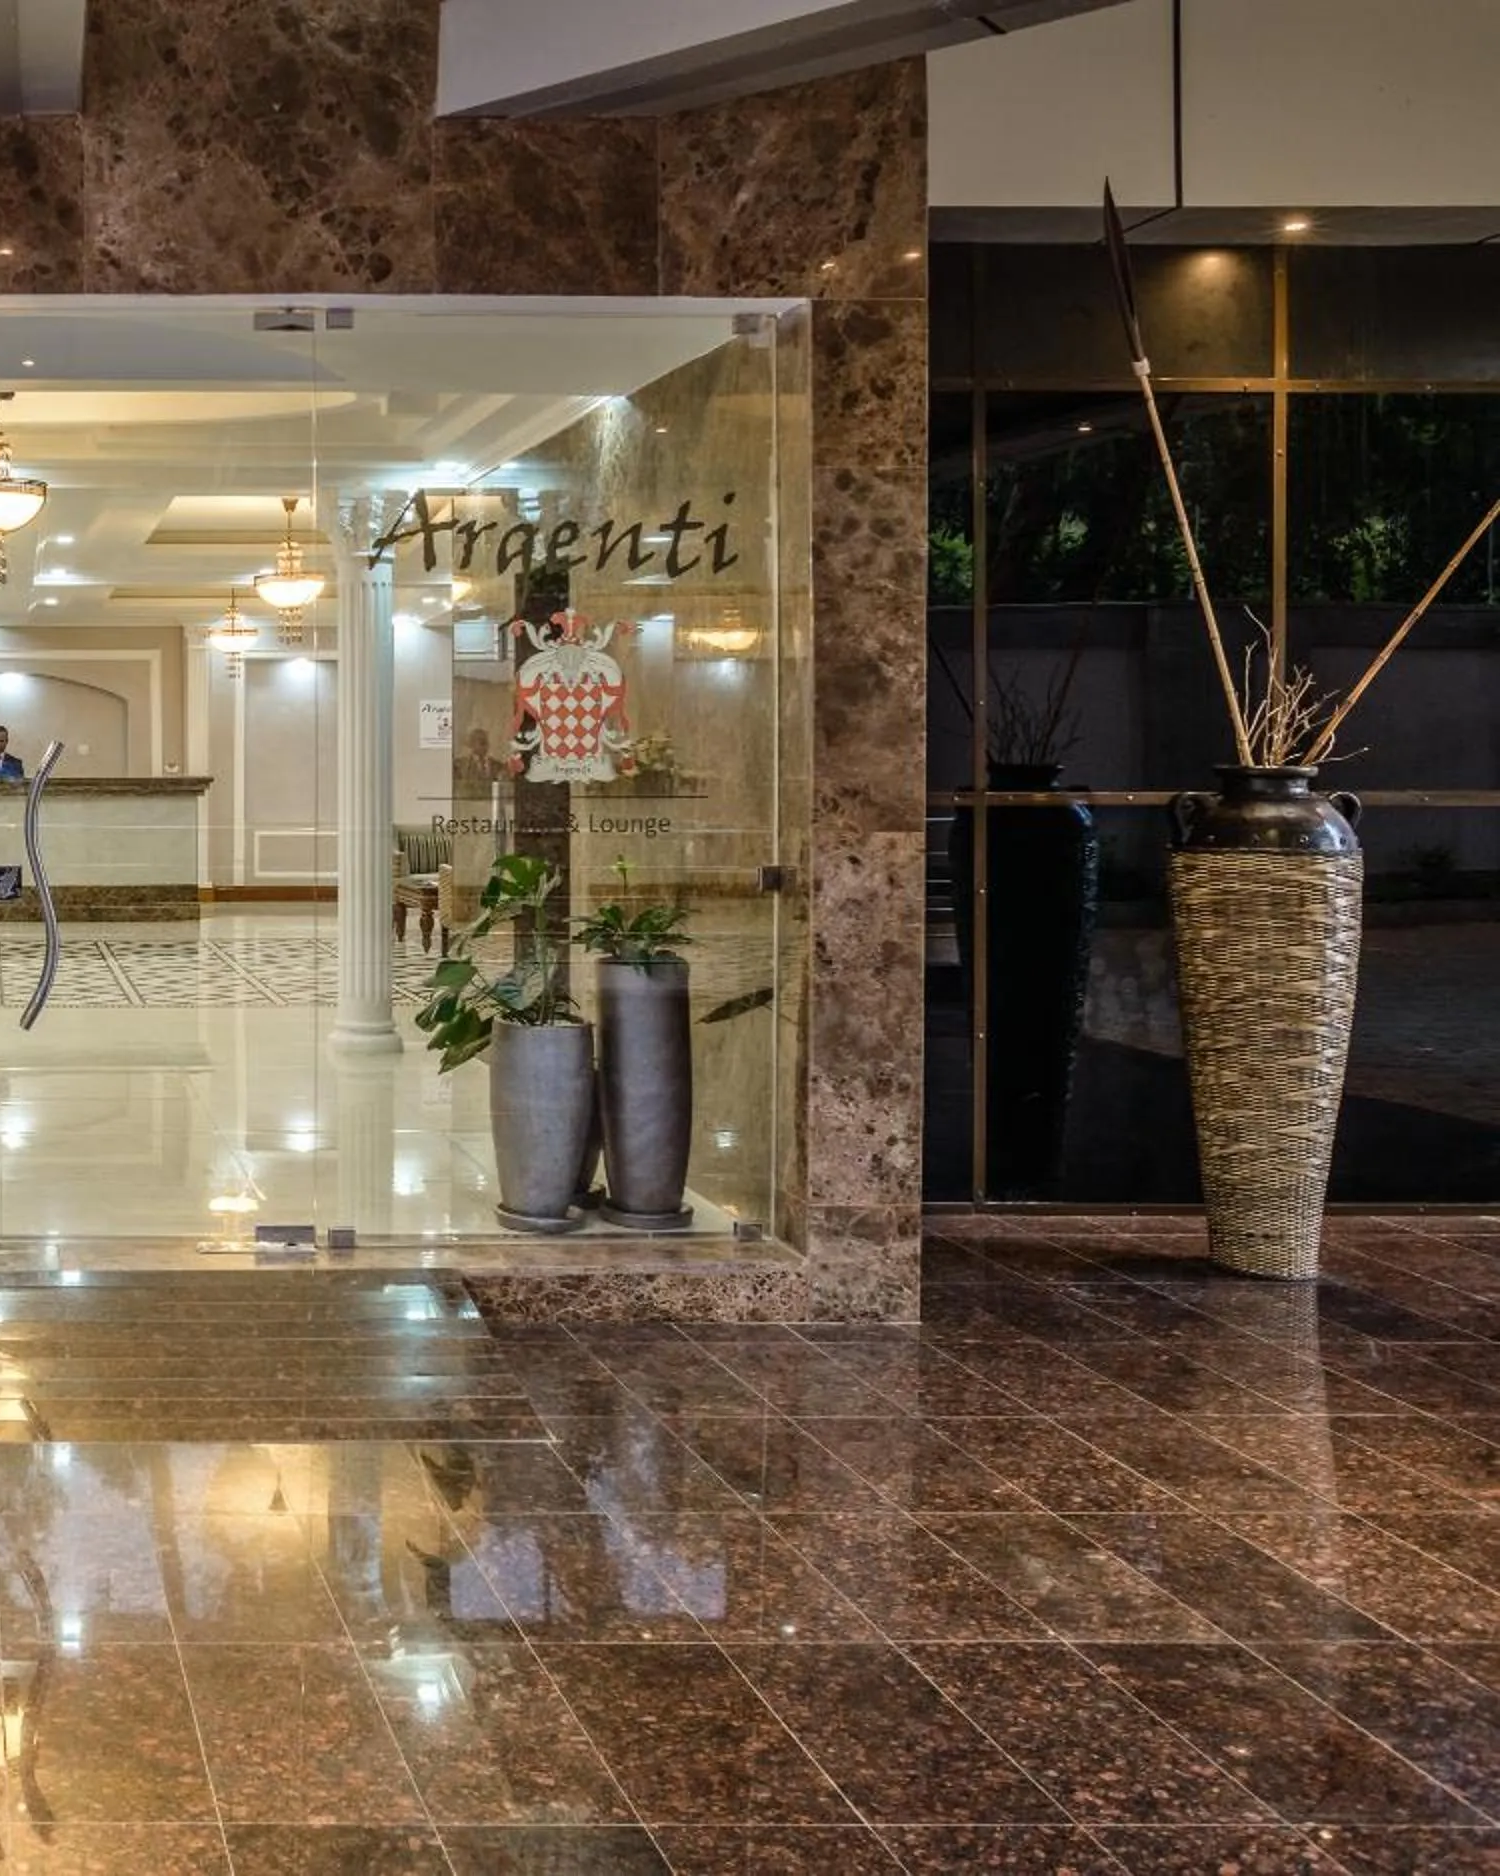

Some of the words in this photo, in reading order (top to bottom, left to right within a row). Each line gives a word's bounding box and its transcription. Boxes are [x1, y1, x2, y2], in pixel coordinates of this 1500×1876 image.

[368, 487, 739, 598] Argenti
[431, 814, 554, 835] Restaur
[565, 813, 580, 833] &
[588, 813, 671, 837] Lounge
